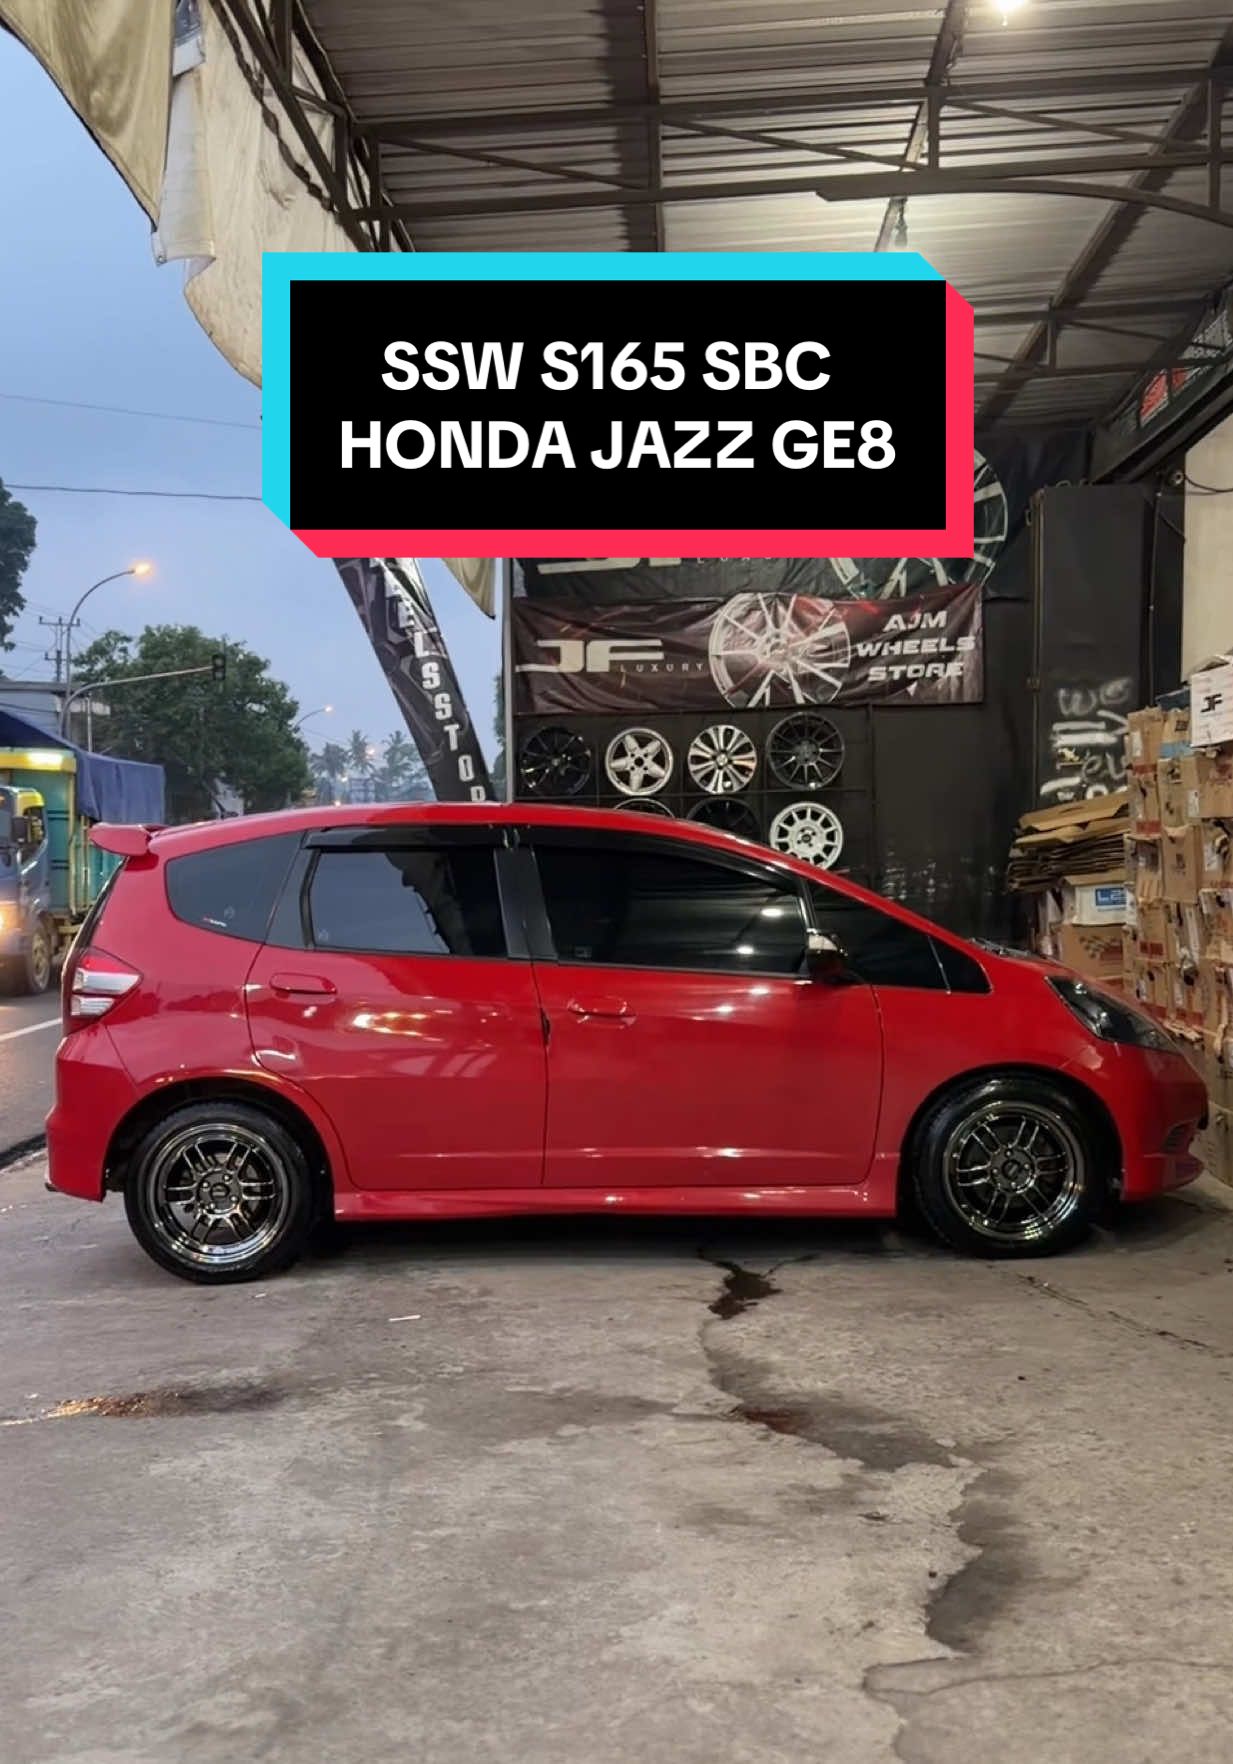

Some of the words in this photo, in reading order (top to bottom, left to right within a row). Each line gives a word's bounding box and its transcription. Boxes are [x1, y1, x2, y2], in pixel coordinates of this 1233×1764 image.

[882, 610, 948, 633] AJM
[515, 639, 665, 673] JF
[619, 663, 704, 673] LUXURY
[856, 636, 976, 657] WHEELS
[867, 661, 965, 682] STORE
